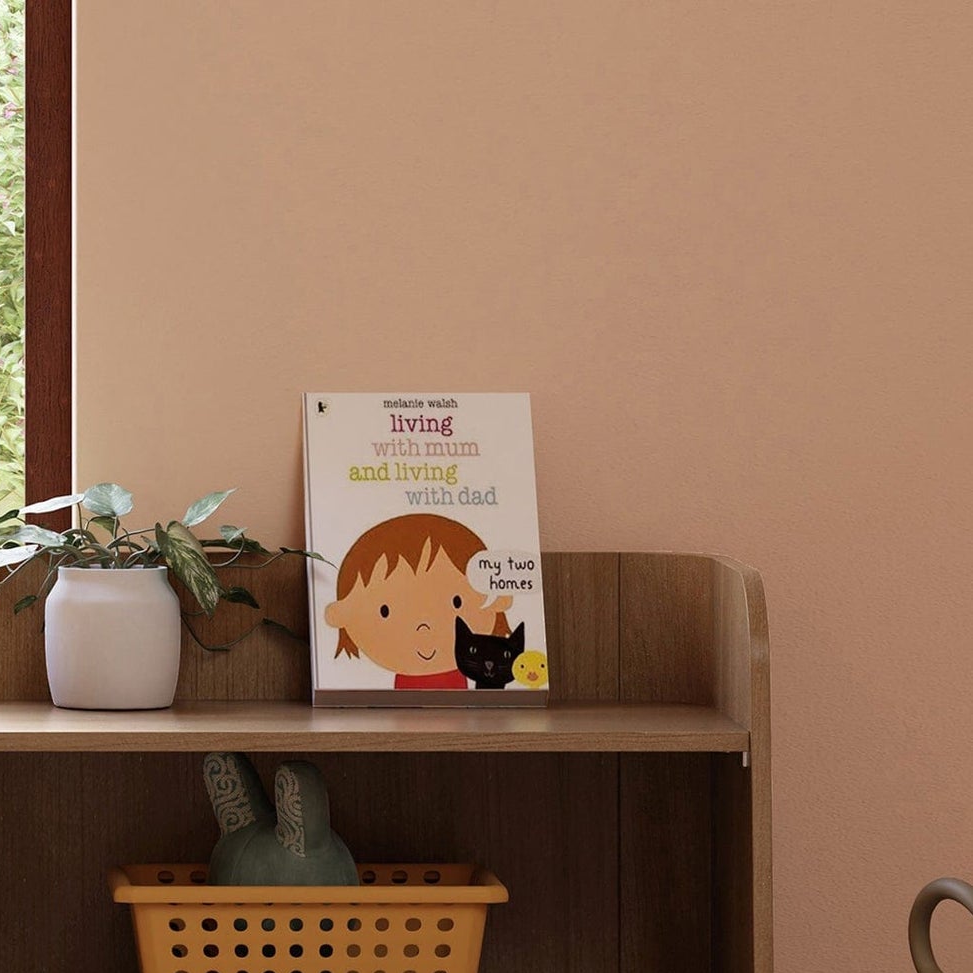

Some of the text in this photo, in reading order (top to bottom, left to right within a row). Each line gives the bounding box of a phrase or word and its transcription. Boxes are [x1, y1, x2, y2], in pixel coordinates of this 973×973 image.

[383, 398, 458, 409] melanie walsh
[390, 414, 453, 436] living
[372, 438, 481, 457] with mum
[349, 463, 458, 485] and living
[405, 487, 498, 505] with dad
[479, 558, 535, 575] my two
[489, 574, 533, 590] homes
